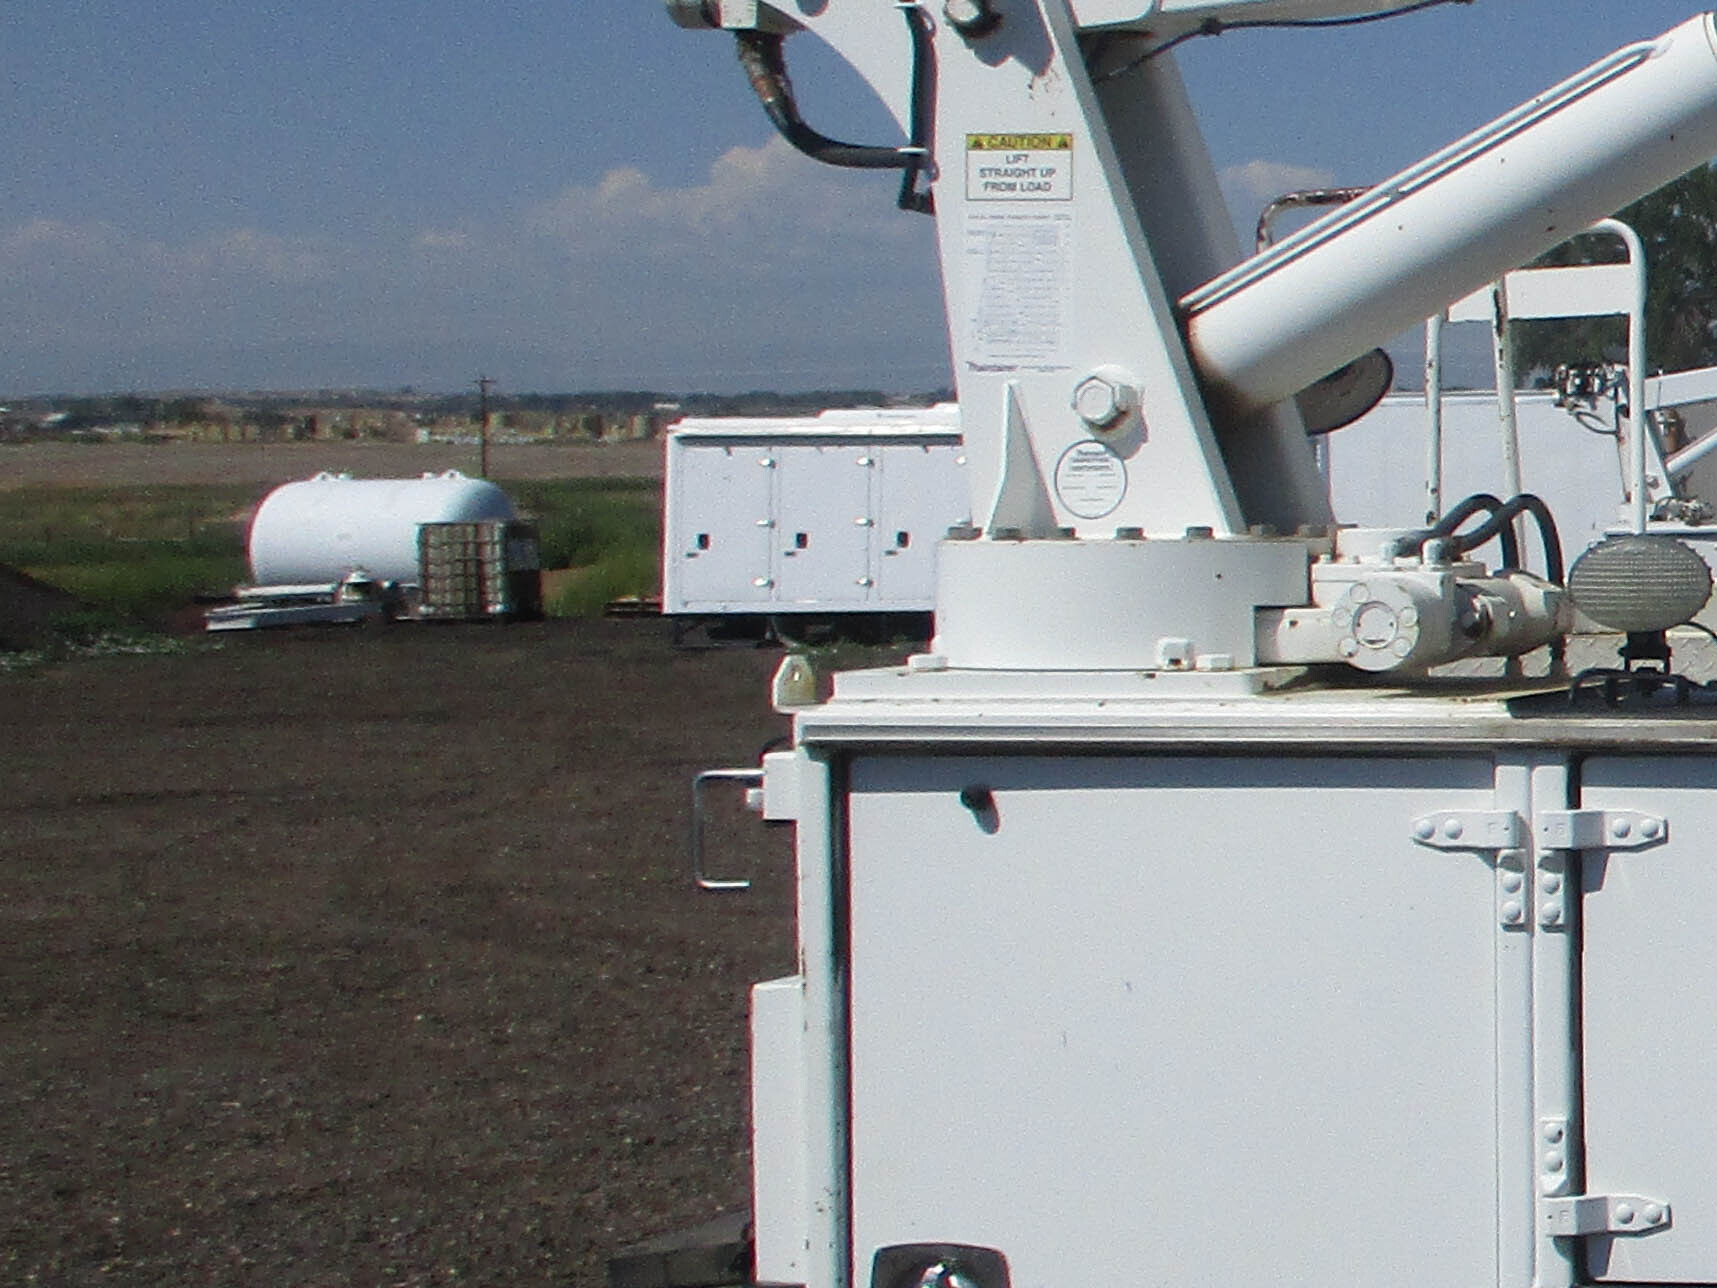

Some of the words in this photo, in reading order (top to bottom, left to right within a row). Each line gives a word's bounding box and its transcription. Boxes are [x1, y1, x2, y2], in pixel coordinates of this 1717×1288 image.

[986, 135, 1052, 148] CAUTION
[1005, 153, 1029, 164] LIFT
[979, 167, 1036, 178] STRAIGHT
[1040, 167, 1056, 178] UP
[984, 181, 1016, 192] FROM
[1021, 181, 1052, 192] LOAD
